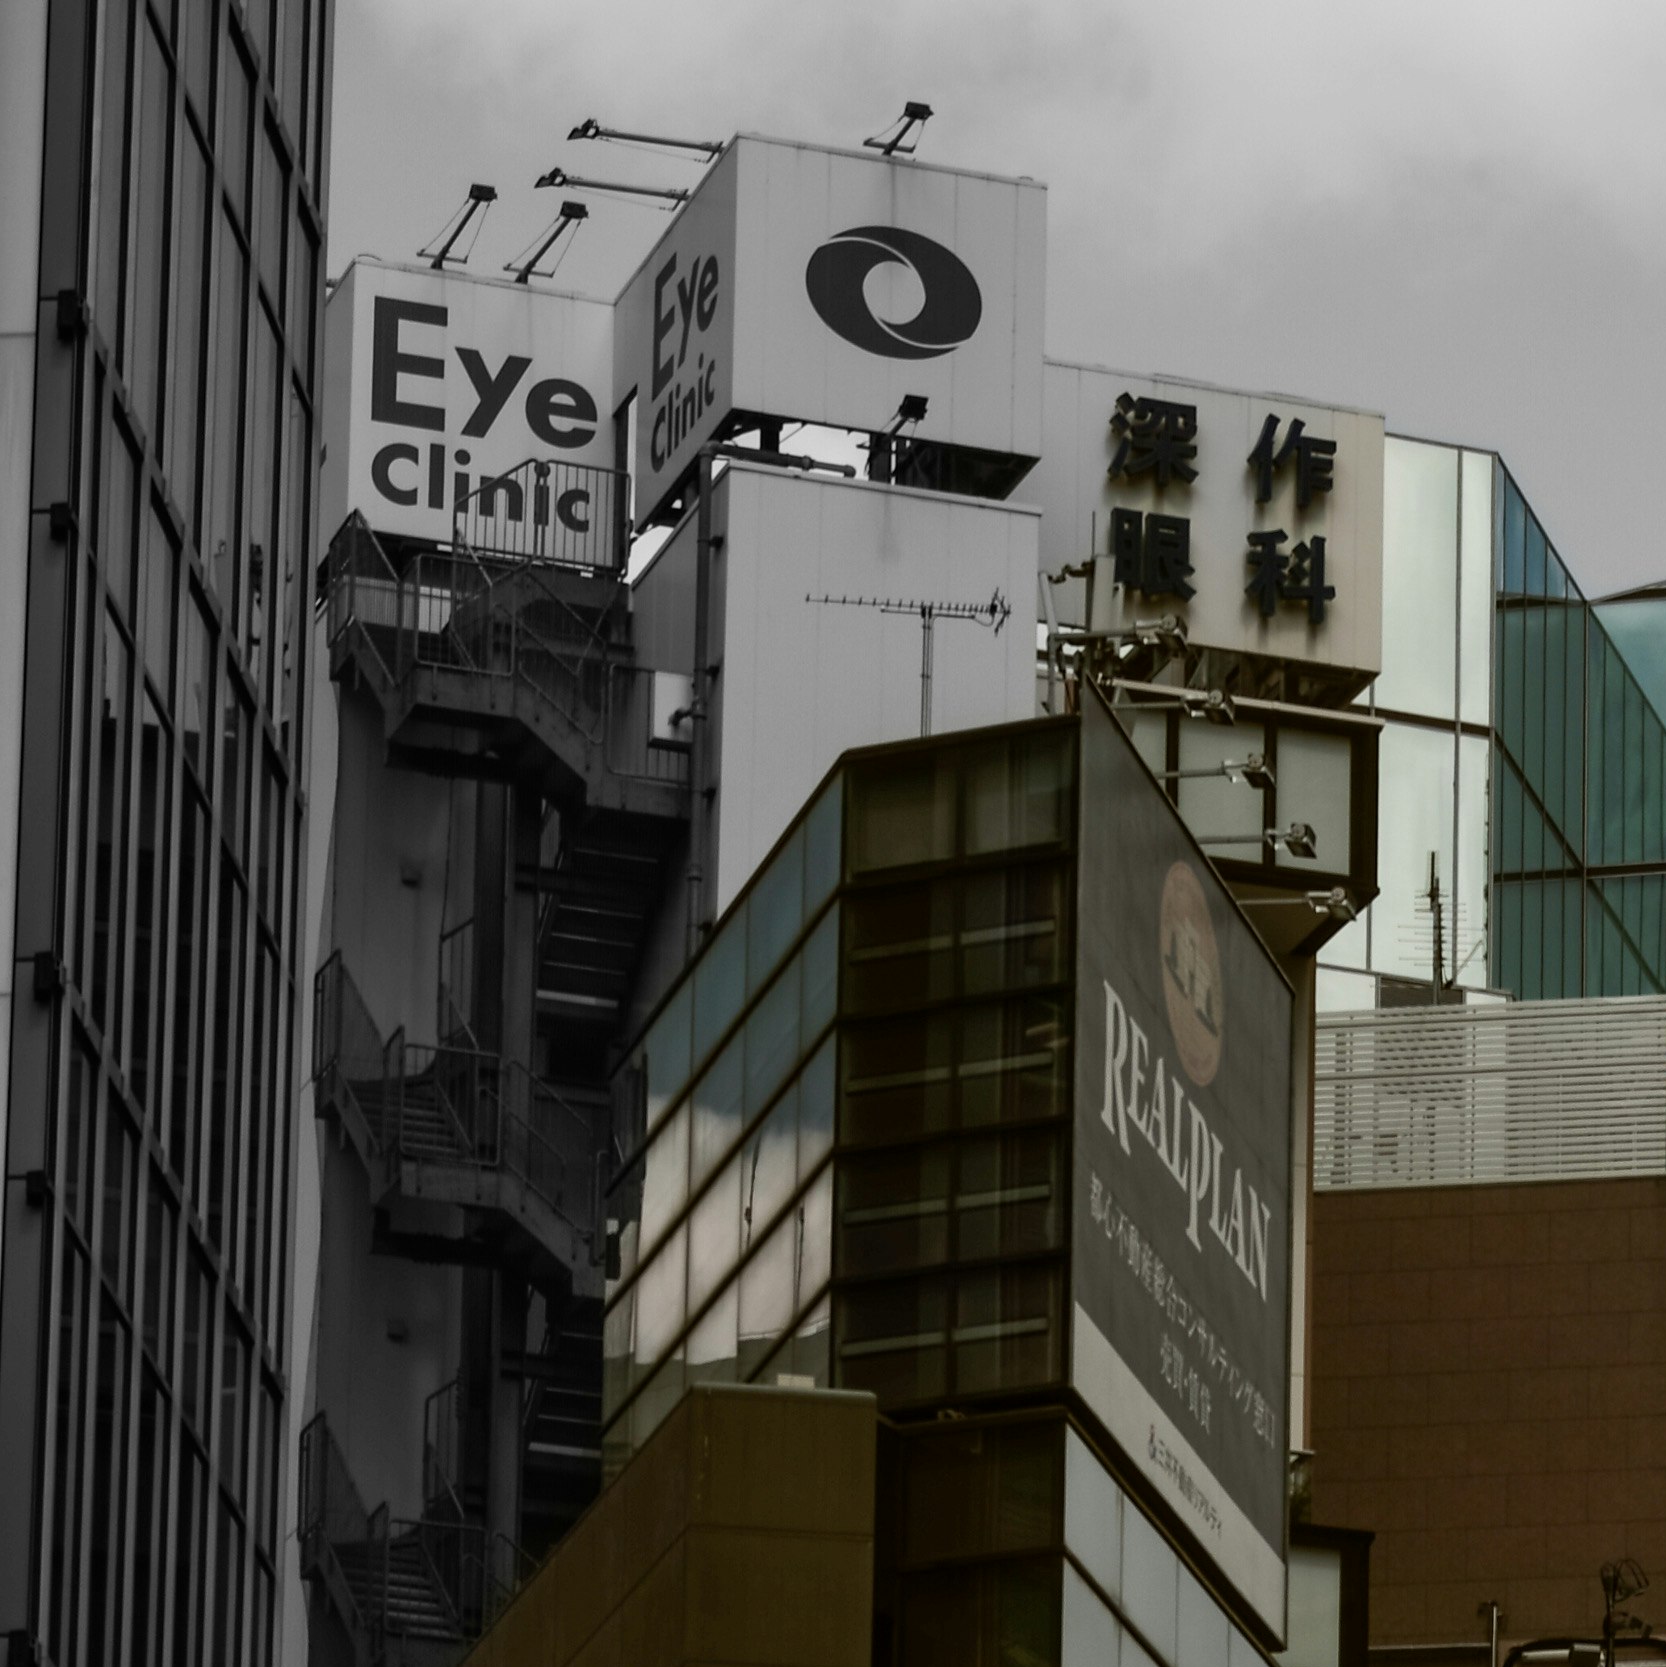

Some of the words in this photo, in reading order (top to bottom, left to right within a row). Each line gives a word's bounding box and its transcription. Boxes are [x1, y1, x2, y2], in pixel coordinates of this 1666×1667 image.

[371, 295, 598, 449] Eye
[652, 252, 720, 402] Eye
[650, 352, 716, 474] Clinic
[1107, 391, 1337, 507] 深作
[371, 442, 590, 533] Clinic
[1110, 507, 1336, 623] 眼科
[1100, 979, 1270, 1303] REALPLAN
